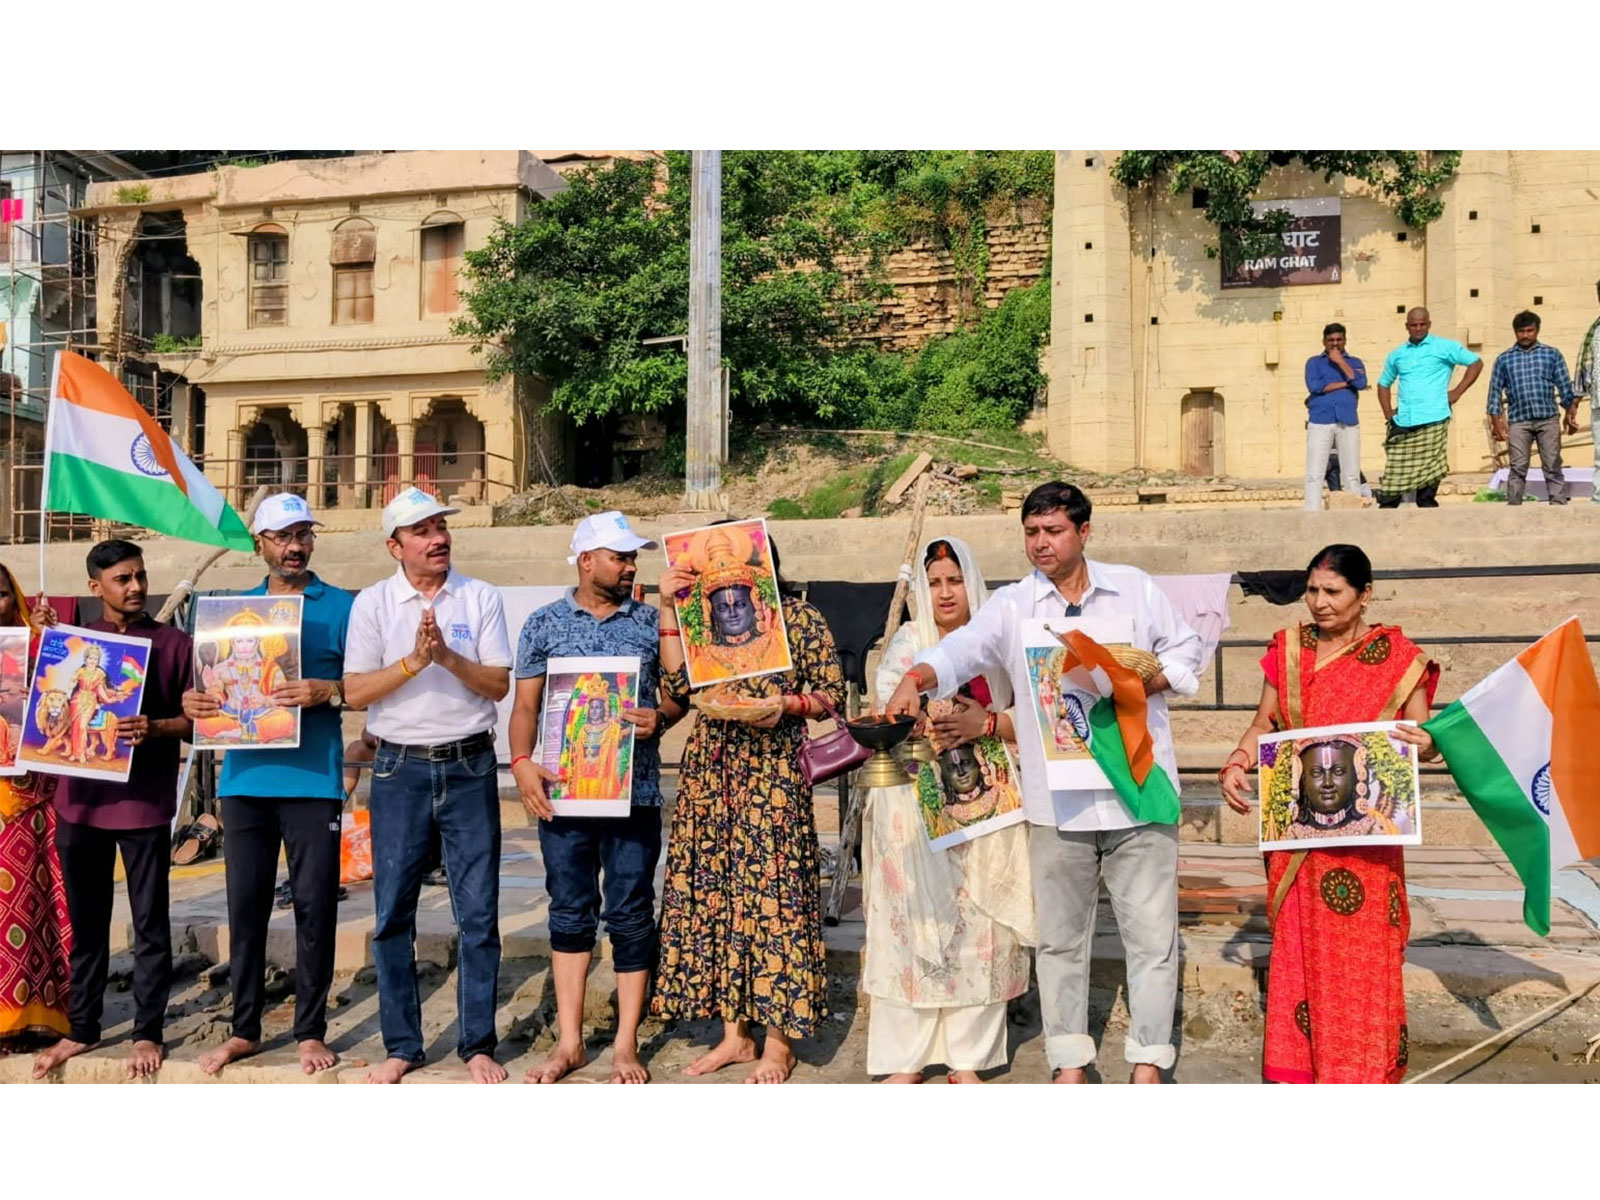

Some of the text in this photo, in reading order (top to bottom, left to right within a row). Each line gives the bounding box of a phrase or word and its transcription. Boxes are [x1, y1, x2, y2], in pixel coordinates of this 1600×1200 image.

[1282, 231, 1320, 248] घाट
[1244, 255, 1317, 271] RAM GHAT
